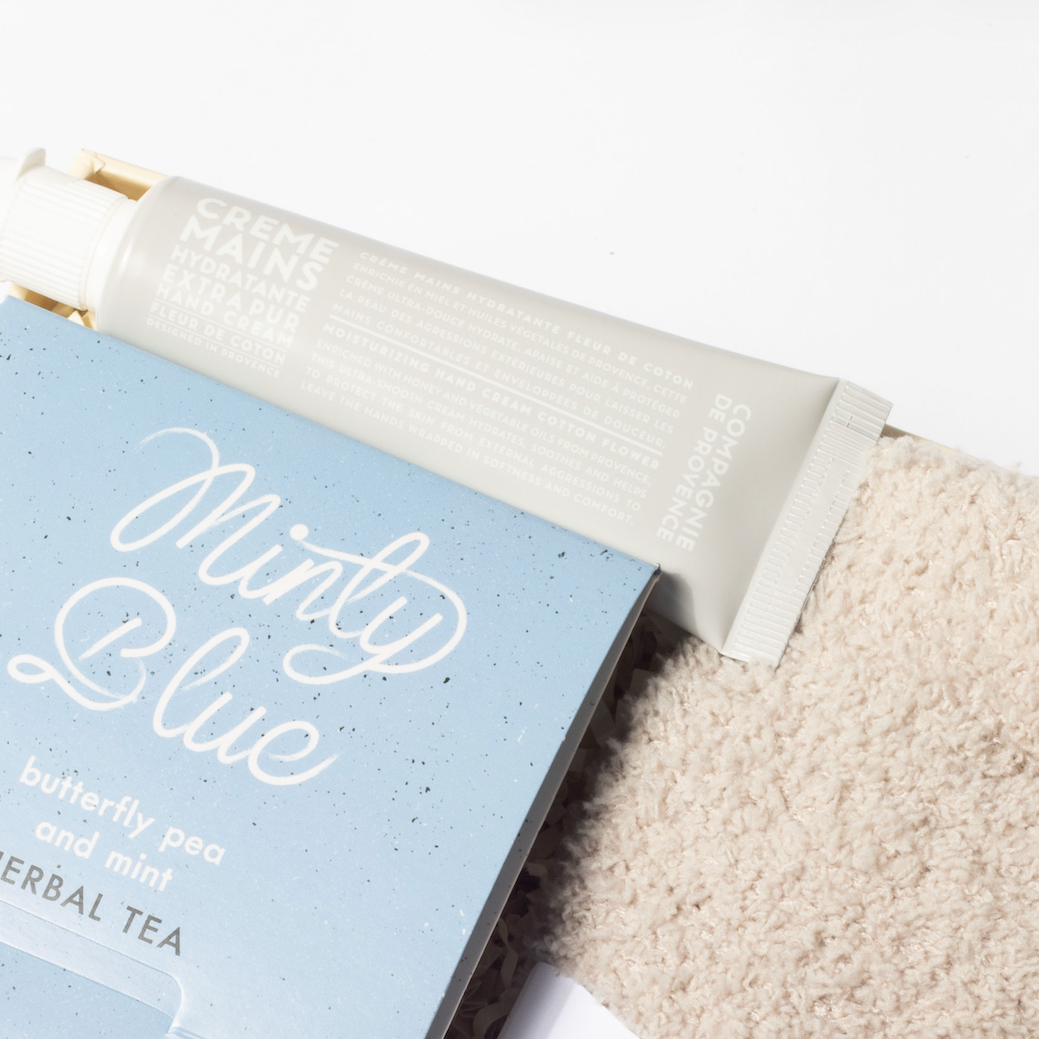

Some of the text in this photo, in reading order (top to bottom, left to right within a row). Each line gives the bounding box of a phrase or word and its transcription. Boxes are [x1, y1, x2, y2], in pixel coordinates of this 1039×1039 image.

[170, 244, 311, 313] HYDRATANTE
[179, 215, 324, 291] MAINS
[197, 198, 340, 264] CREME
[146, 317, 280, 378] DESIGNED IN PROVENCE
[150, 302, 286, 365] FLEUR DE COTON
[156, 282, 294, 349] HAND CREAM
[161, 263, 300, 333] EXTRA PUR
[353, 262, 406, 288] ENRICHIE
[407, 283, 423, 295] EN
[425, 290, 449, 306] MIEL
[453, 301, 467, 311] ET
[468, 307, 507, 328] HUILES
[571, 349, 587, 362] DE
[653, 384, 687, 404] CETTE
[414, 271, 460, 294] MAINS
[467, 292, 561, 334] HYDRATANTE
[567, 331, 611, 355] FLEUR
[618, 351, 637, 366] DE
[644, 363, 693, 390] COTON
[316, 339, 372, 367] ENRICHED
[375, 362, 402, 379] WITH
[403, 374, 442, 395] HONEY
[442, 391, 467, 406] AND
[470, 401, 529, 432] VEGETABLE
[530, 427, 555, 443] OILS
[557, 438, 589, 458] FROM
[323, 323, 660, 470] MOISTURIZING HAND CREAM COTTON FLOWER
[332, 303, 371, 325] MAINS
[376, 321, 470, 365] CONFORTABLES
[475, 361, 490, 372] ET
[582, 406, 599, 419] DE
[339, 288, 352, 300] LA
[357, 295, 387, 313] PEAU
[390, 309, 413, 324] DES
[416, 320, 487, 354] AGRESSIONS
[568, 383, 601, 403] POUR
[605, 398, 650, 423] LAISSER
[654, 419, 674, 434] LES
[524, 348, 563, 369] APAISE
[566, 364, 580, 375] ET
[581, 372, 609, 388] AIDE
[301, 380, 336, 401] LEAVE
[340, 396, 361, 412] THE
[364, 406, 404, 429] HANDS
[409, 424, 463, 453] WRAPPED
[466, 448, 480, 460] IN
[483, 455, 542, 486] SOFTNESS
[544, 482, 570, 497] AND
[307, 366, 641, 511] TO PROTECT THE SKIN FROM EXTERNAL AGGRESSIONS TO
[312, 352, 335, 369] THIS
[427, 400, 465, 421] CREAM
[531, 443, 582, 470] SOOTHES
[585, 466, 610, 482] AND
[613, 478, 647, 498] HELPS
[656, 393, 733, 542] DE PROVENCE
[676, 404, 752, 551] COMPAGNIE
[110, 426, 467, 685] Minty
[7, 576, 340, 786] Blue
[19, 755, 226, 865] butterfly pea
[35, 822, 173, 891] and mint
[0, 850, 180, 956] ERBAL TEA
